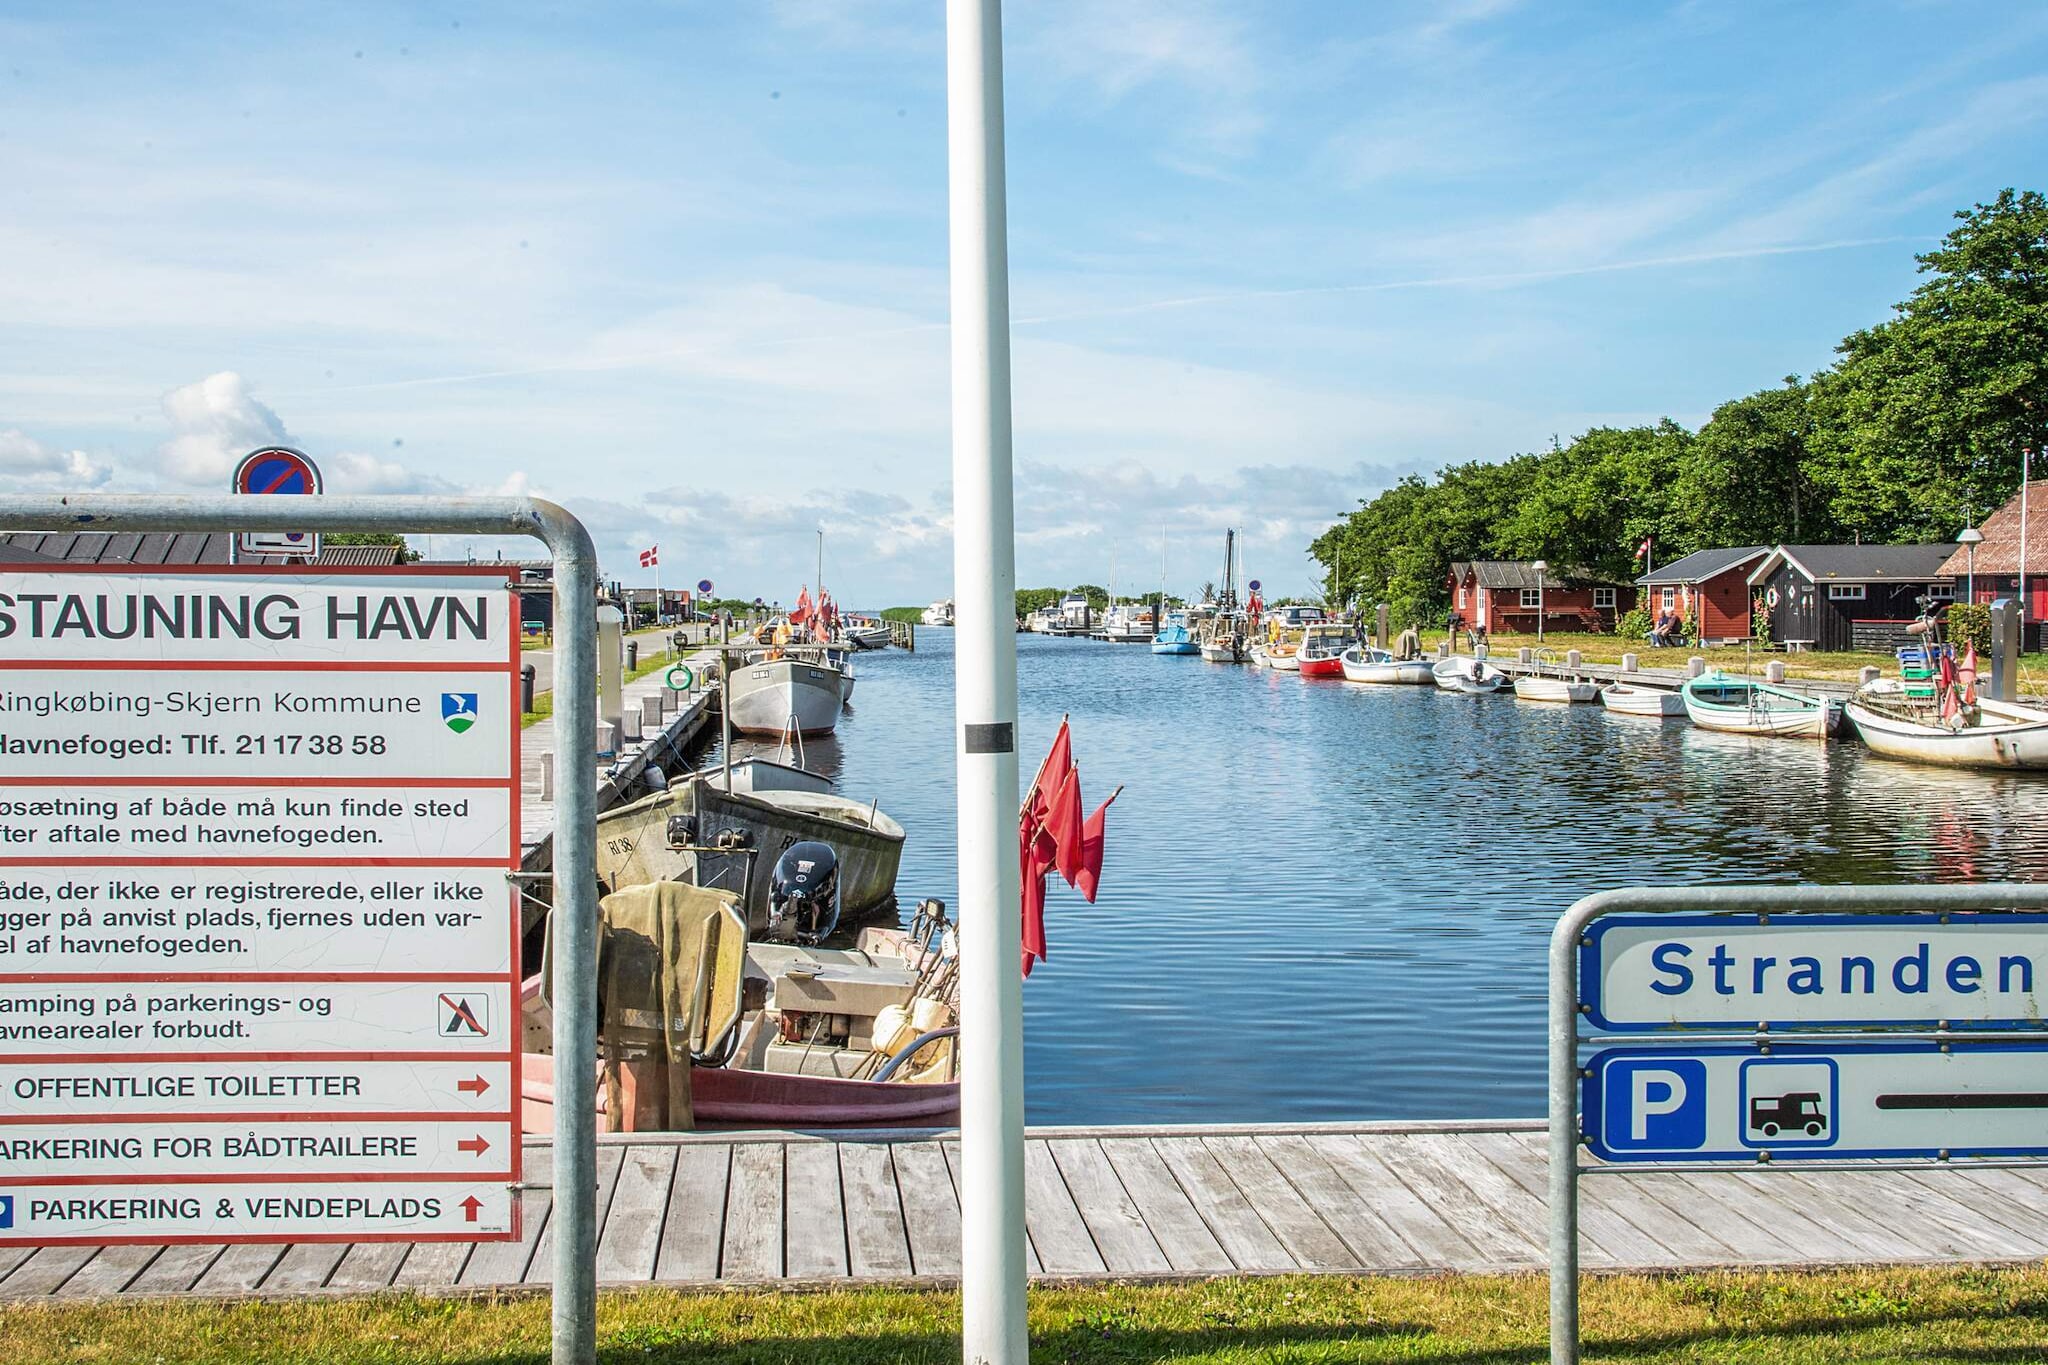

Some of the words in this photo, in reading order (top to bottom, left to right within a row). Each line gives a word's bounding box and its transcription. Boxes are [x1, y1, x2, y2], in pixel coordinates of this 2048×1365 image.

[328, 596, 487, 640] HAVN
[0, 691, 260, 716] ingkøbing-Skjern
[275, 693, 421, 712] Kommune
[181, 735, 226, 755] Tlf.
[129, 798, 152, 816] af
[163, 797, 226, 817] både
[238, 798, 274, 816] må
[286, 798, 330, 816] kun
[341, 798, 402, 816] finde
[414, 799, 468, 817] sted
[49, 825, 120, 843] aftale
[132, 825, 186, 843] med
[198, 825, 383, 848] havnefogeden.
[57, 882, 99, 900] der
[109, 882, 159, 900] ikke
[171, 886, 196, 900] er
[206, 881, 364, 904] registrerede,
[371, 882, 424, 900] eller
[435, 882, 483, 900] ikke
[61, 907, 92, 931] på
[103, 908, 176, 927] anvist
[186, 908, 260, 931] plads,
[267, 908, 353, 931] fjernes
[364, 909, 424, 927] uden
[435, 913, 483, 927] var-
[27, 935, 50, 954] af
[61, 935, 248, 957] havnefogeden.
[1650, 943, 2033, 996] Stranden
[106, 993, 136, 1016] på
[148, 994, 291, 1016] parkerings-
[299, 998, 331, 1017] og
[153, 1020, 250, 1039] forbudt.
[14, 1077, 195, 1098] OFFENTLIGE
[204, 1076, 361, 1097] TOILETTER
[1631, 1069, 1688, 1141] P
[154, 1138, 211, 1158] FOR
[224, 1132, 417, 1158] BÅDTRAILERE
[31, 1199, 201, 1221] PARKERING
[216, 1199, 235, 1219] &
[245, 1198, 441, 1219] VENDEPLADS
